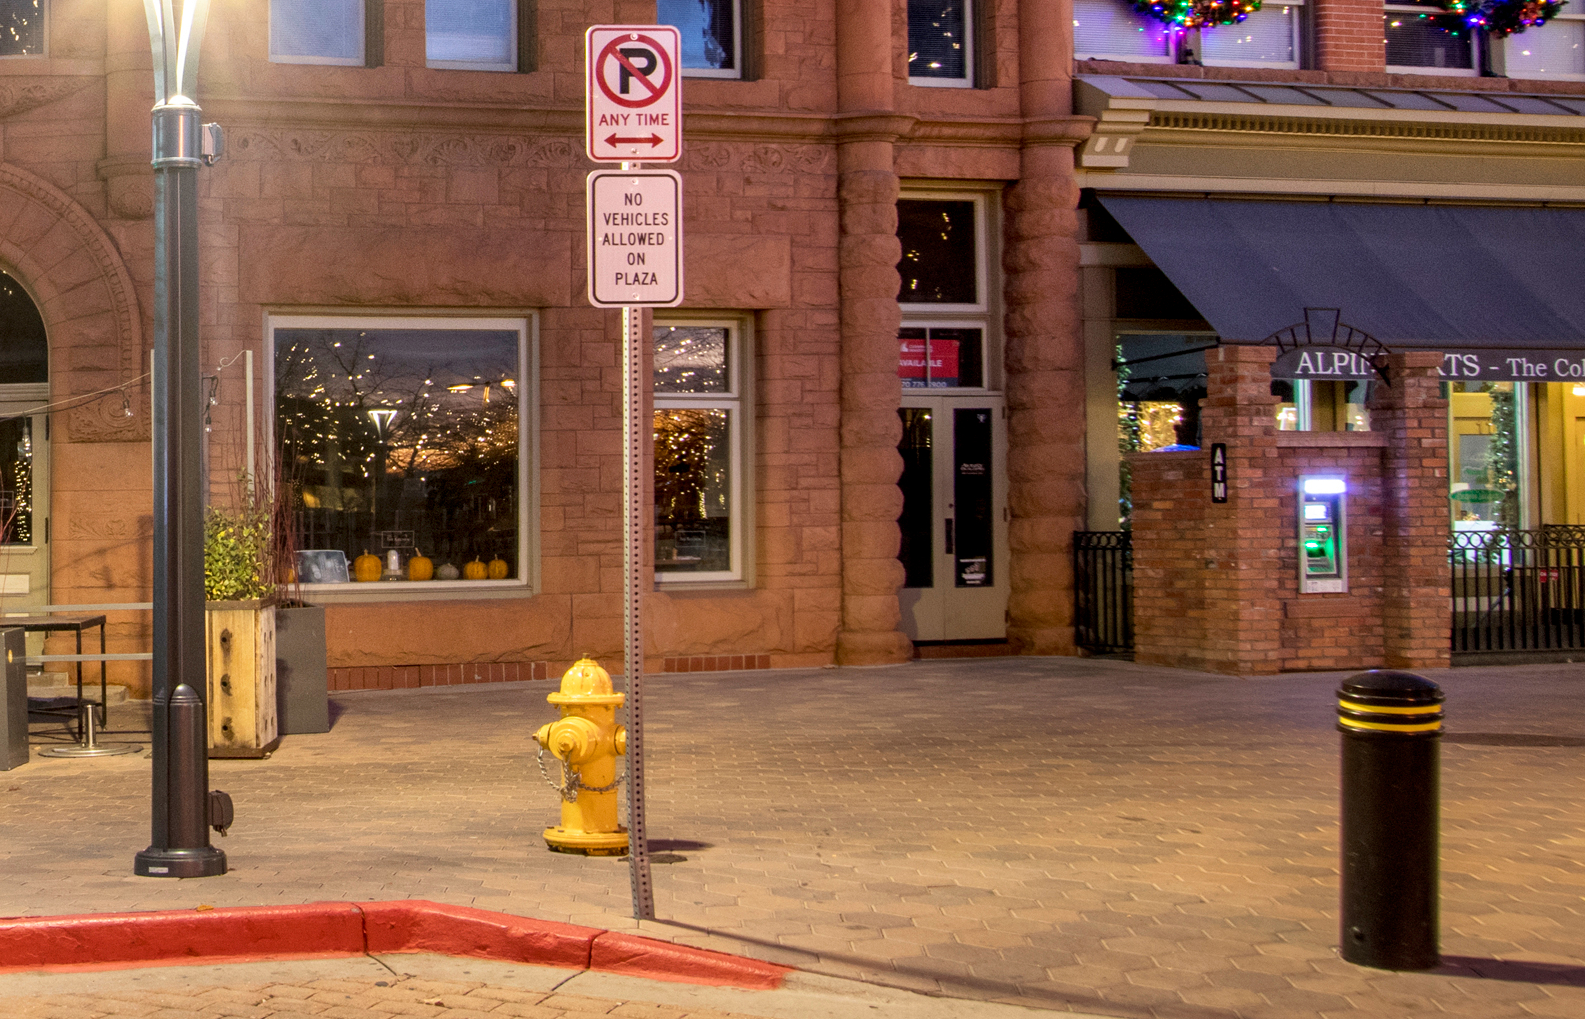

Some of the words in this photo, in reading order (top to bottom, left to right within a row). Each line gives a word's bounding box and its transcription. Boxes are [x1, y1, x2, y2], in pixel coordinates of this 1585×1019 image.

[599, 113, 630, 127] ANY
[636, 112, 670, 127] TIME
[624, 192, 643, 206] NO
[603, 212, 669, 227] VEHICLES
[602, 232, 665, 246] ALLOWED
[627, 252, 645, 266] ON
[615, 272, 658, 286] PLAZA
[1295, 351, 1388, 376] ALPIN
[1505, 357, 1548, 377] The
[1214, 446, 1226, 498] ATM
